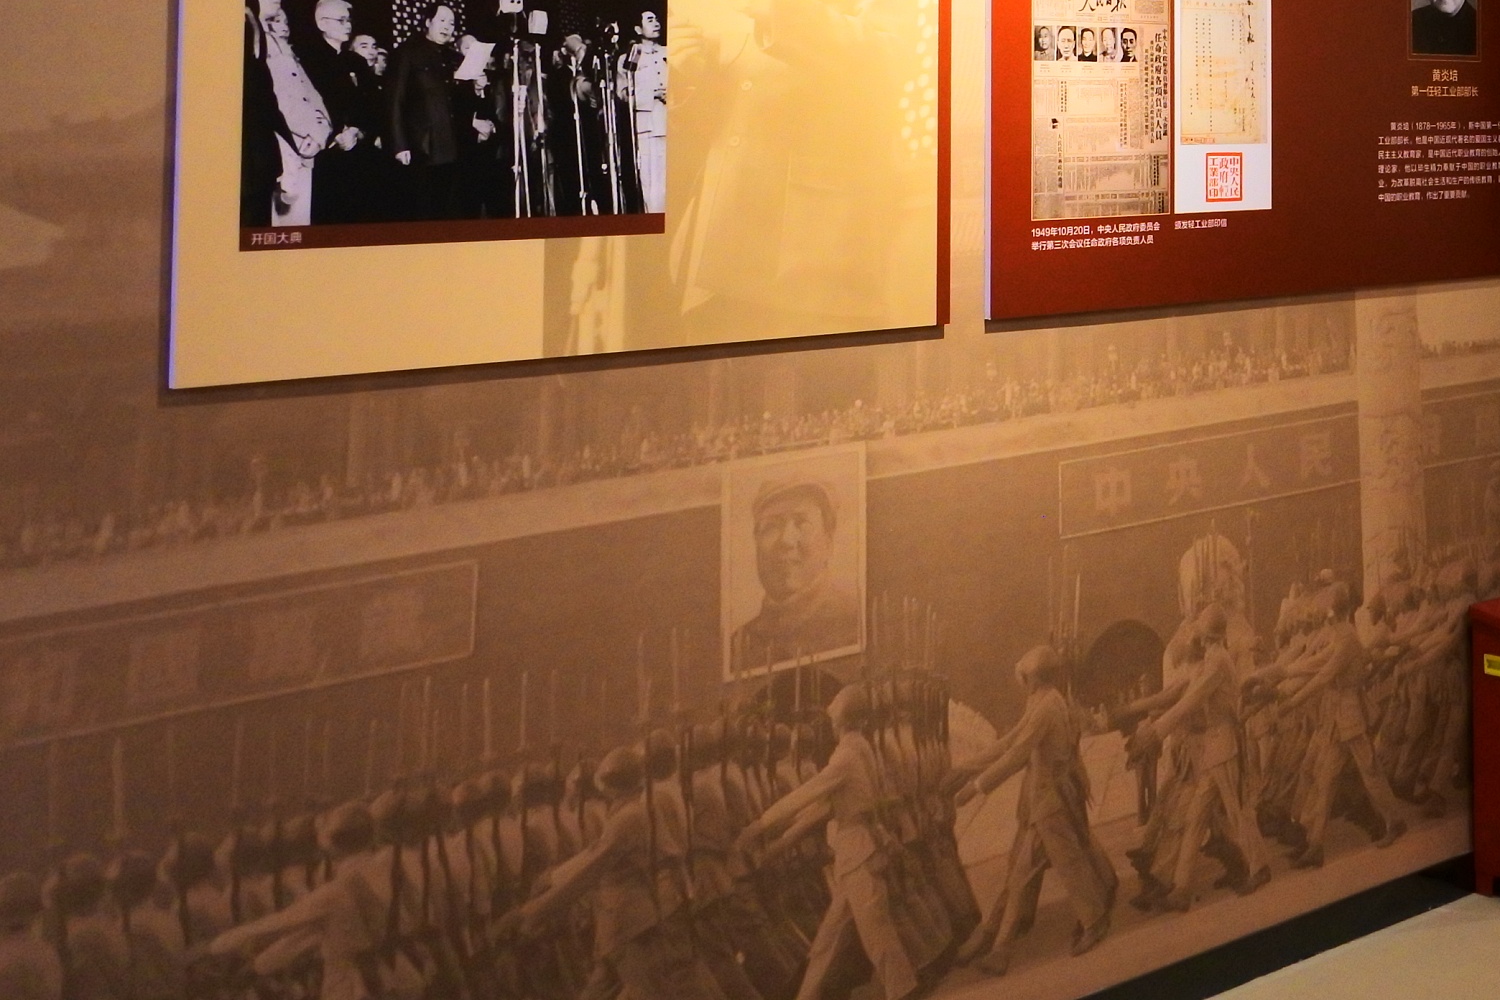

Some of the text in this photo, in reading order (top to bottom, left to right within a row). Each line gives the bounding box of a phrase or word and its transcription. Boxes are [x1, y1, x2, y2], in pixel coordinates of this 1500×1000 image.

[1432, 69, 1458, 82] 黄炎培
[1411, 85, 1479, 97] 第一任轻工业部部长
[251, 231, 303, 246] 开国大典
